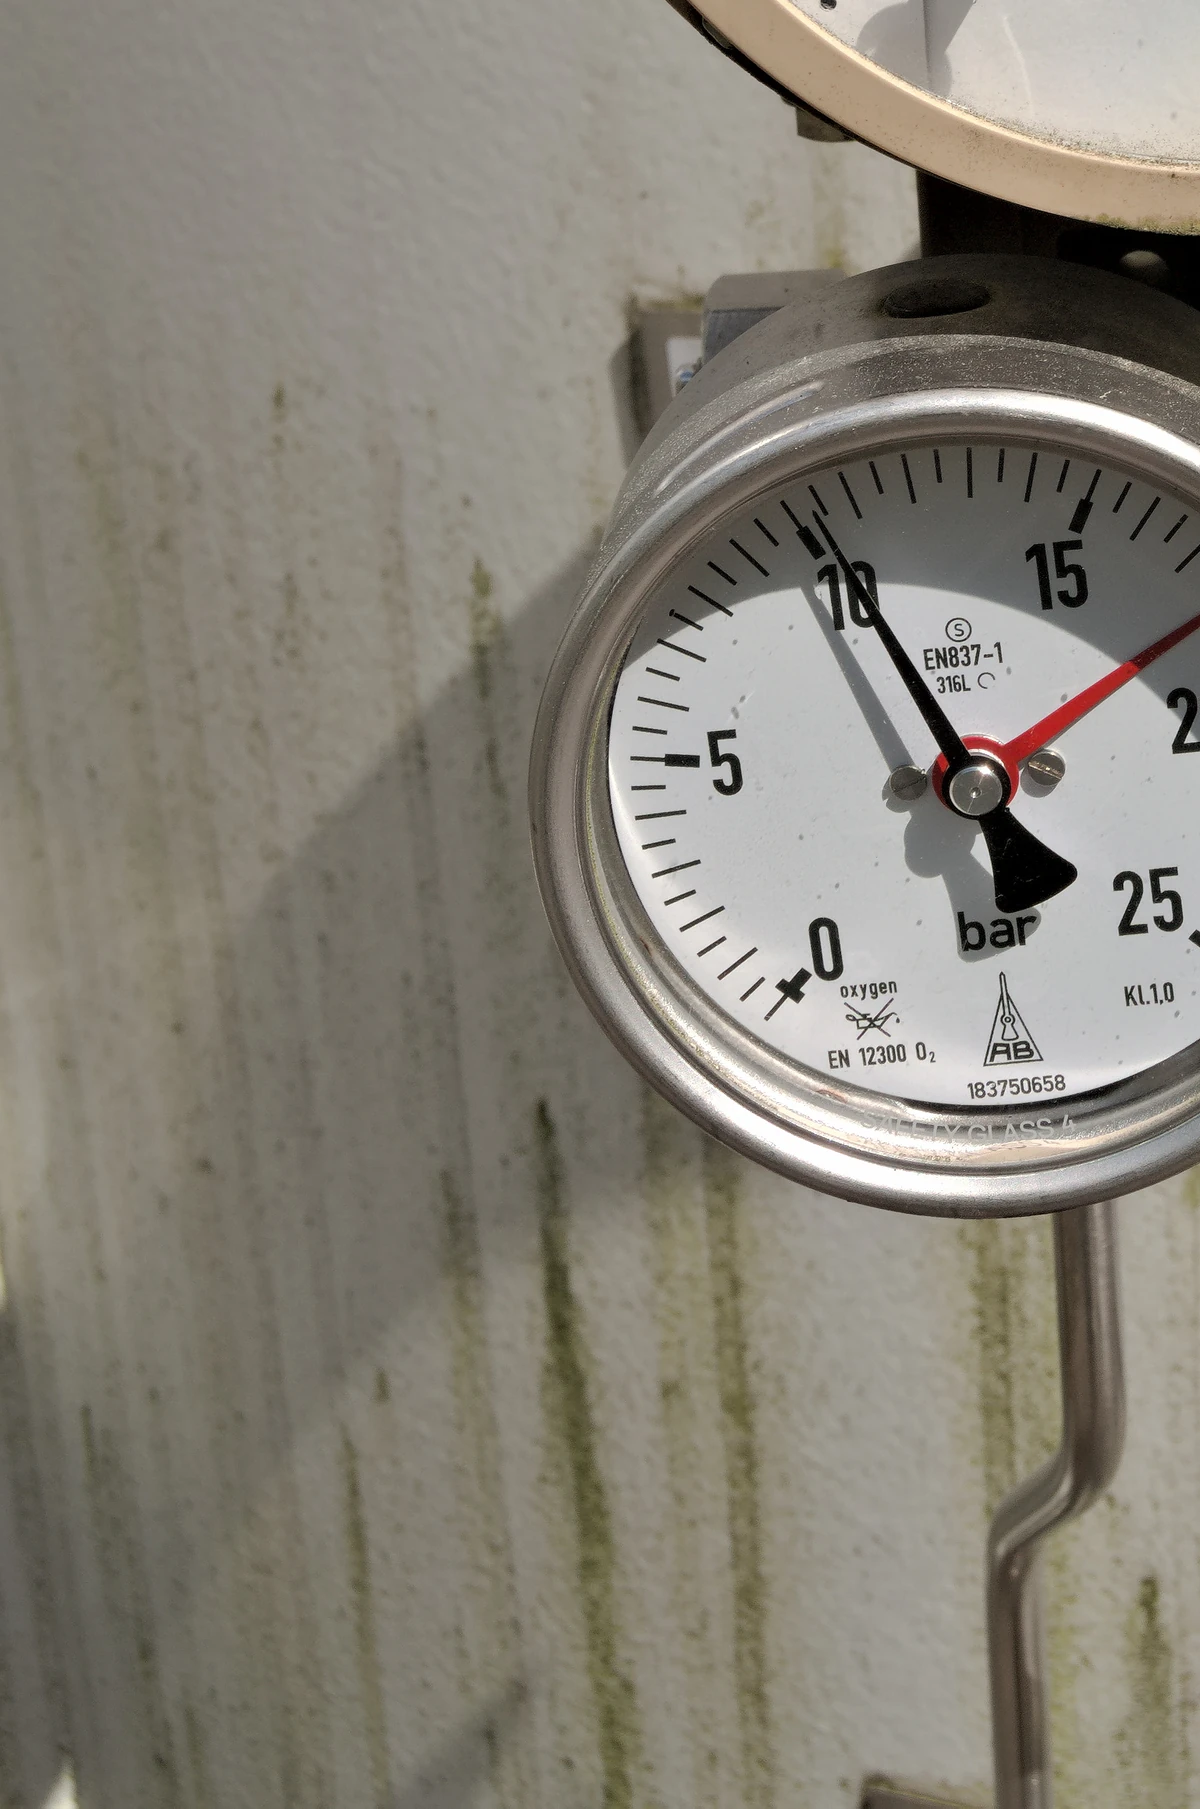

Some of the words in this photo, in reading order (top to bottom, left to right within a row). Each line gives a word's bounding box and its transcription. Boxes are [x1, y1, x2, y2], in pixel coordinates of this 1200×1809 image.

[1024, 539, 1089, 611] 15
[817, 560, 880, 631] 10
[922, 641, 1004, 671] EN837-1
[936, 674, 972, 694] 316L
[706, 728, 744, 796] 5
[1112, 866, 1184, 937] 25
[809, 916, 843, 982] 0
[958, 912, 1037, 953] bar
[839, 980, 898, 1000] oxygen
[827, 1049, 851, 1070] EN
[858, 1043, 907, 1066] 12300
[967, 1074, 1067, 1100] 183750658
[967, 1117, 1055, 1142] GLASS
